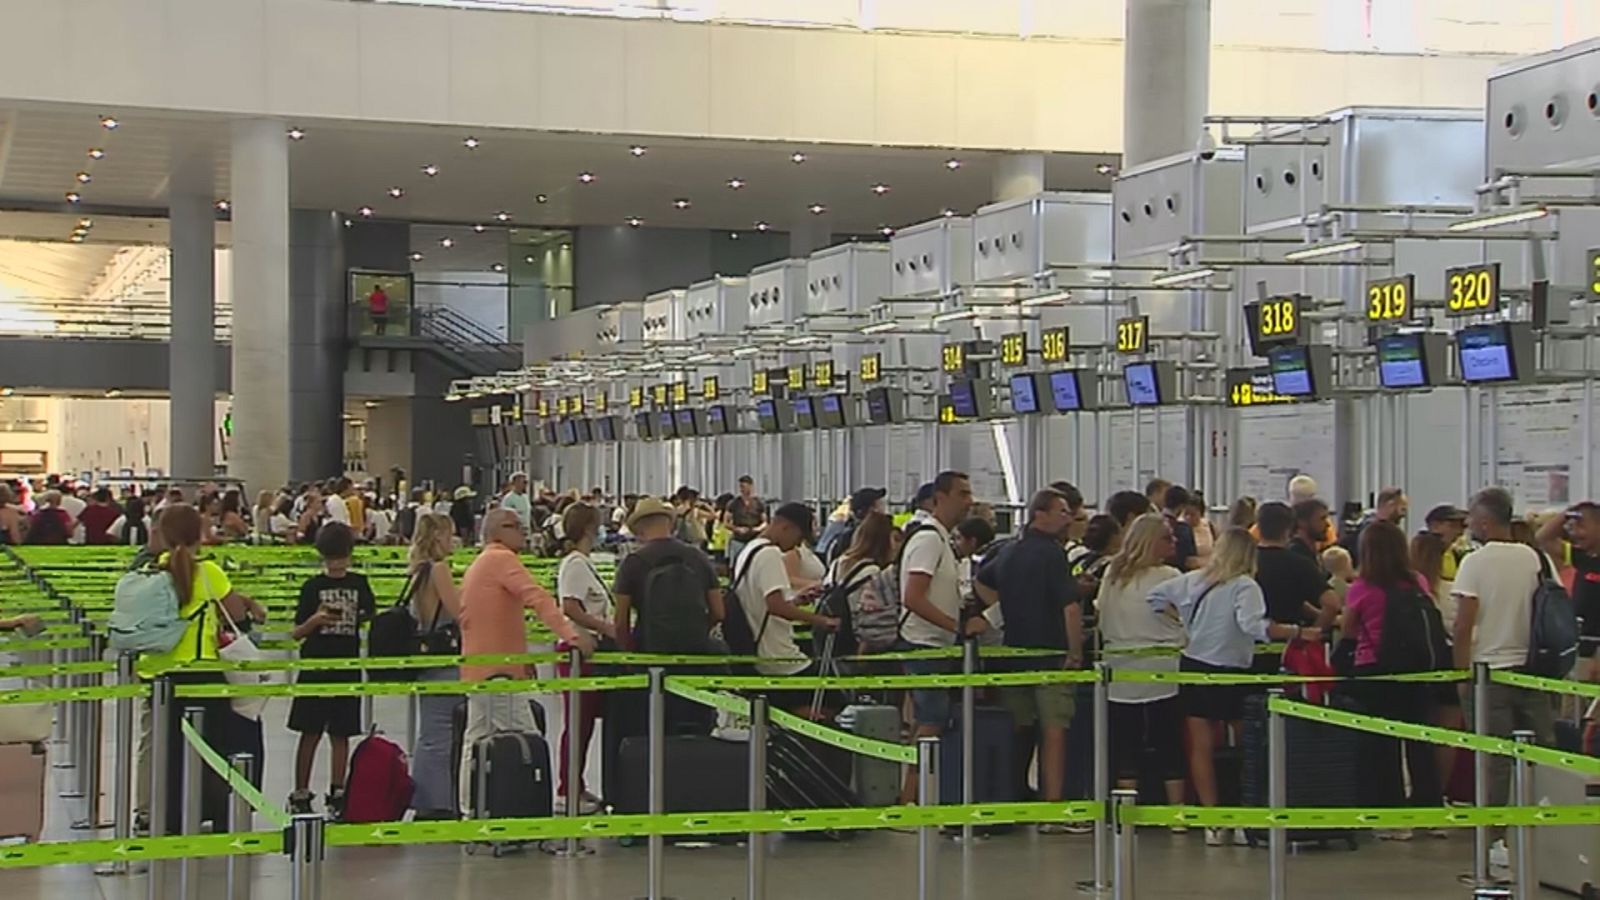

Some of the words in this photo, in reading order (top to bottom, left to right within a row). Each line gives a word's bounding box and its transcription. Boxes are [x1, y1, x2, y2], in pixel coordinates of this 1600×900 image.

[1369, 284, 1406, 319] 319
[1450, 271, 1491, 310] 320
[1262, 301, 1294, 335] 318
[1002, 337, 1022, 363] 315
[1043, 332, 1064, 360] 316
[1118, 322, 1143, 350] 317
